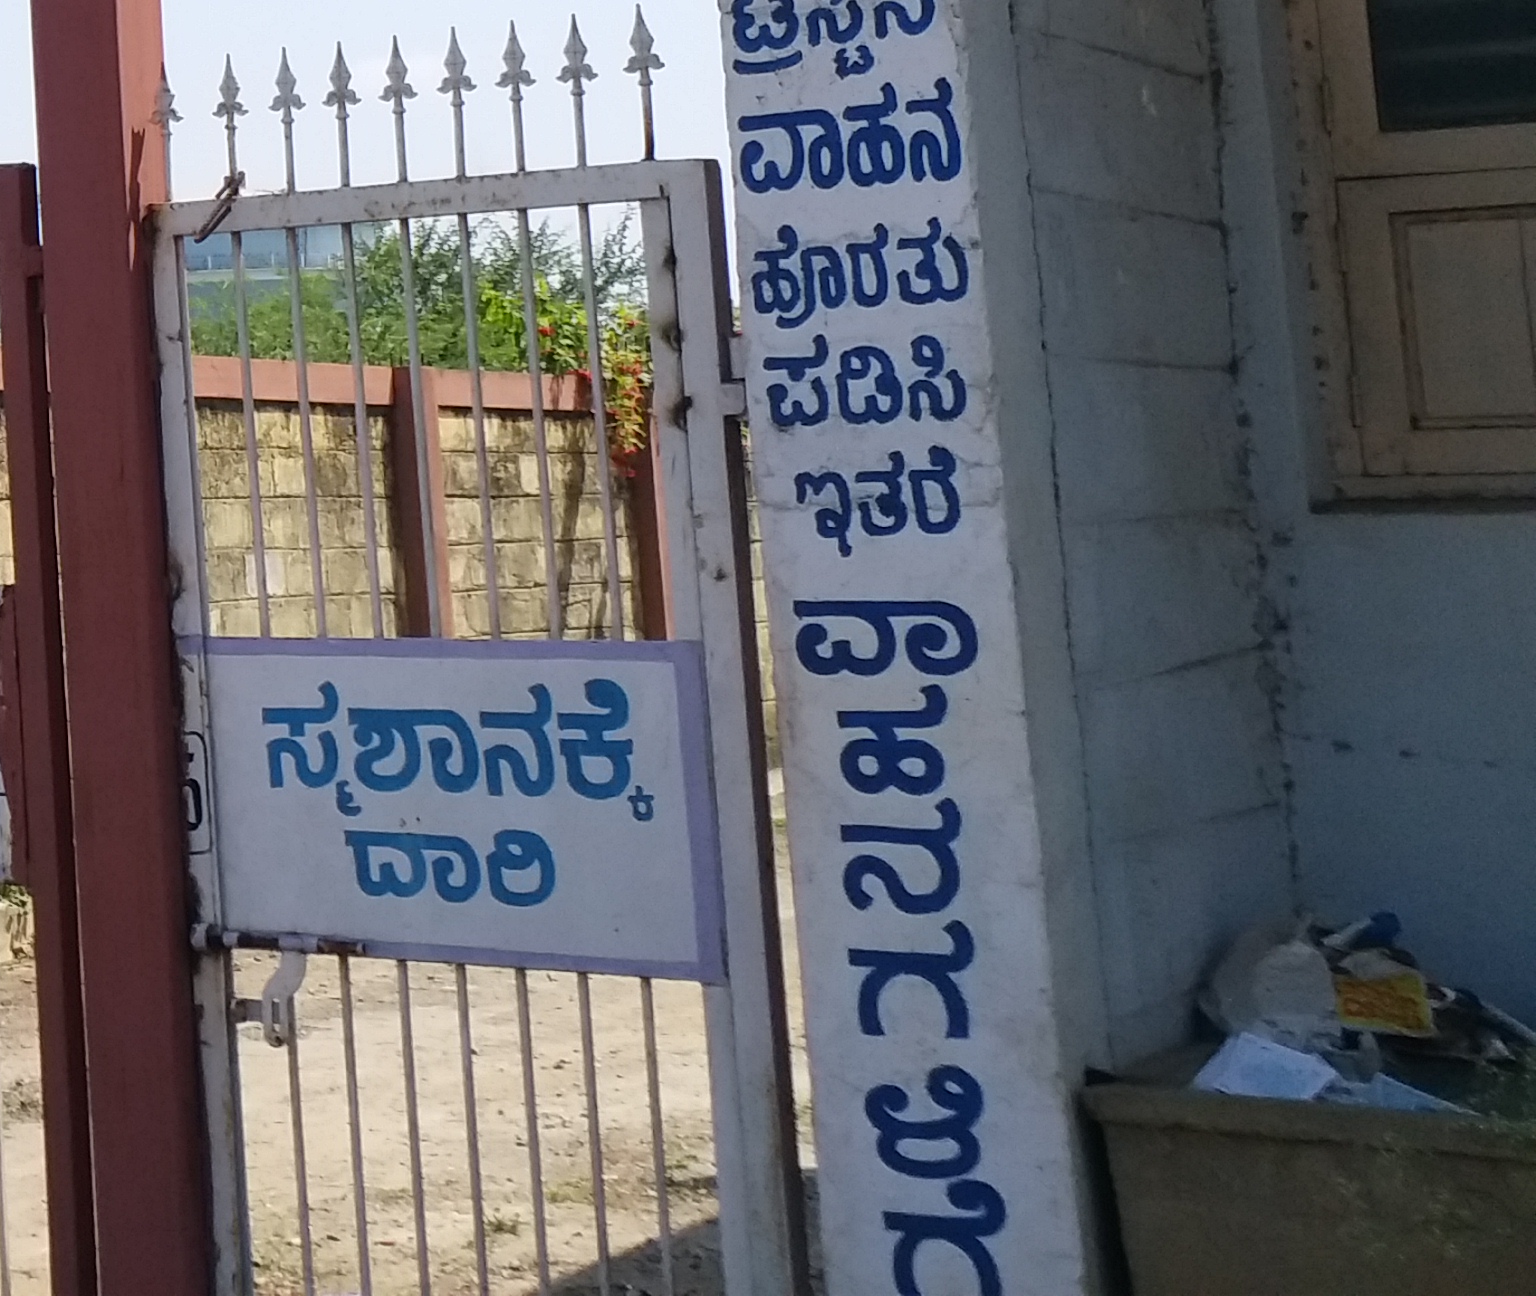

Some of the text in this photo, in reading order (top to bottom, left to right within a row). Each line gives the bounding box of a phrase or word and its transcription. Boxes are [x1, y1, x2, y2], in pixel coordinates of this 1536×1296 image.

[737, 77, 962, 194] ವಾಹನ
[763, 334, 966, 428] ಪಡಿಸಿ
[794, 445, 962, 557] ಇತರೆ
[262, 678, 654, 821] ಸ್ಮಶಾನಕ್ಕೆ
[344, 829, 556, 907] ದಾರಿ
